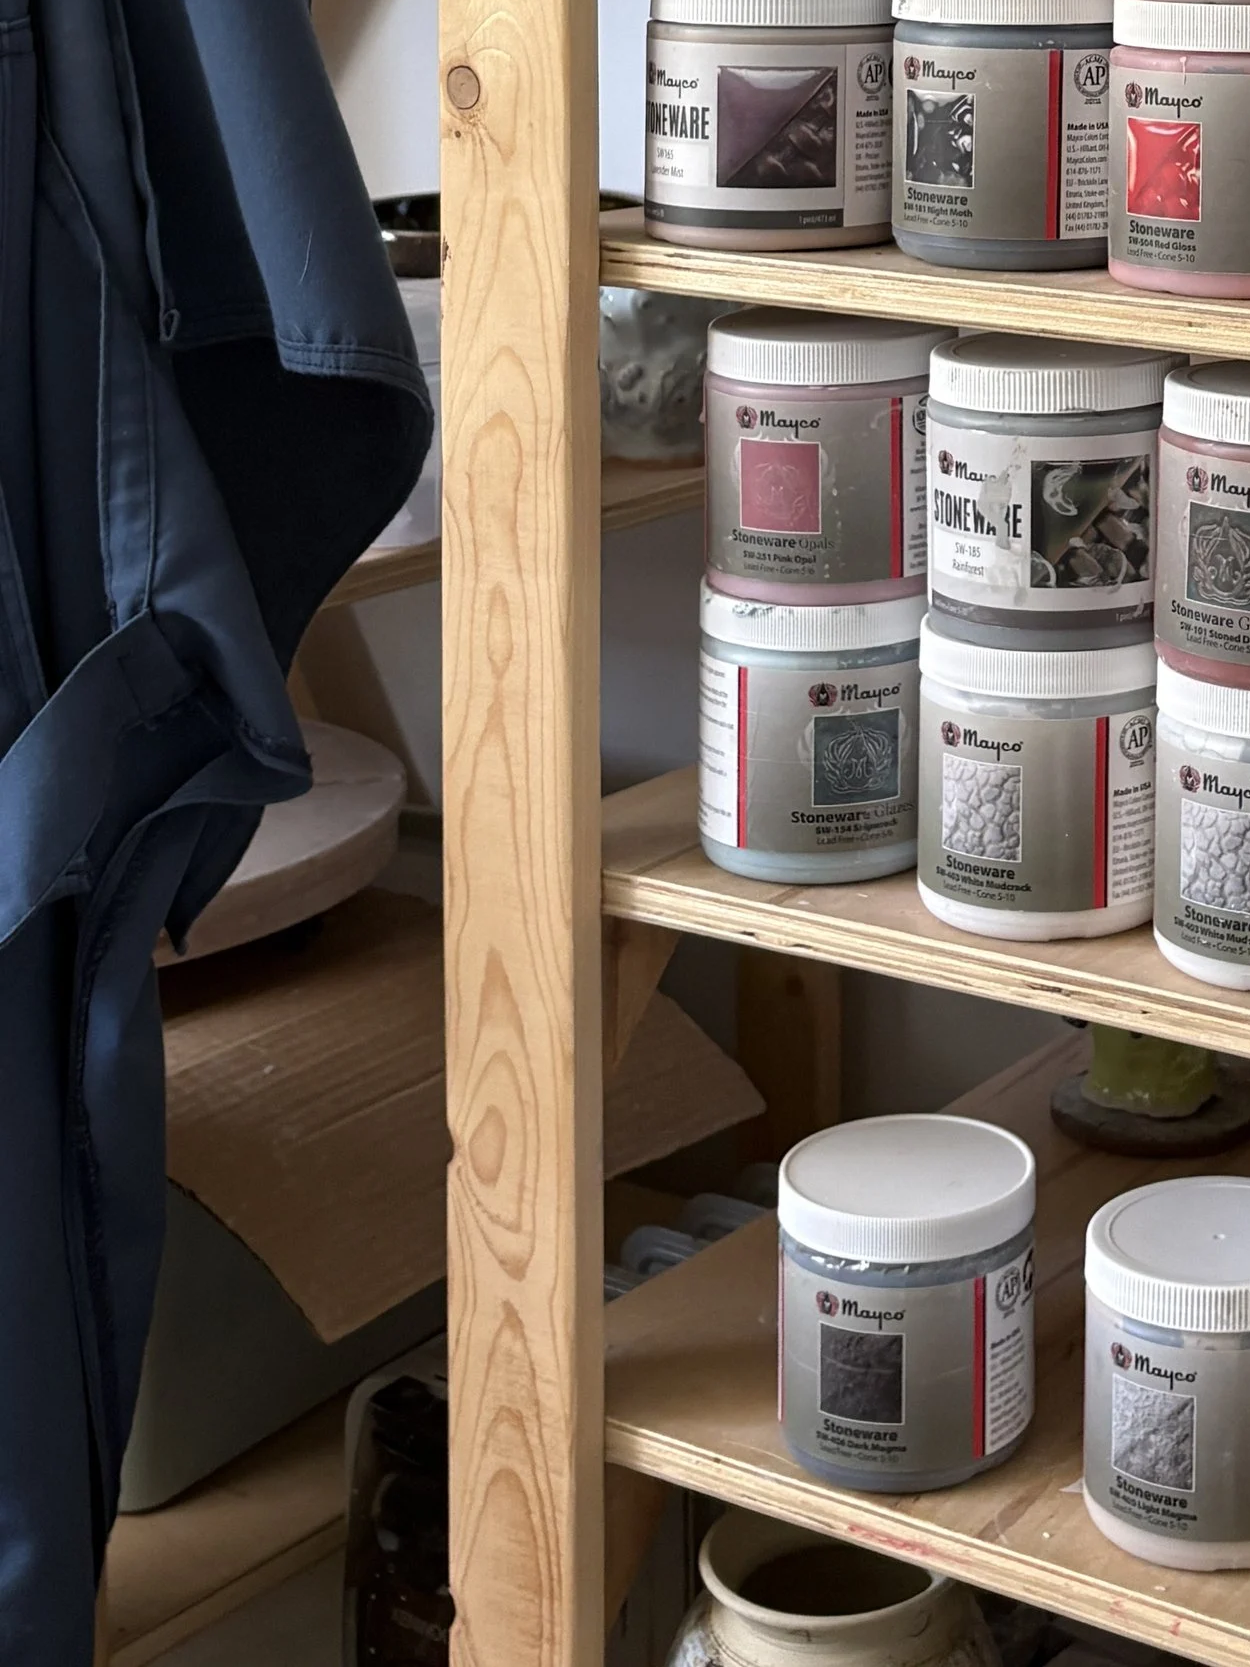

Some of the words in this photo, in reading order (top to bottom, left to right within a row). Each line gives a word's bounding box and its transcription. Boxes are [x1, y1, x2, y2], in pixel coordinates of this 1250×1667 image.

[657, 68, 699, 99] Mayco
[864, 62, 882, 84] AP
[922, 60, 977, 90] Mayco
[1083, 66, 1106, 86] AP
[1144, 87, 1203, 118] Mayco
[907, 188, 968, 206] Stoneware
[1130, 221, 1195, 240] Stoneware
[760, 411, 821, 438] Mayco
[732, 530, 796, 549] Stoneware
[799, 536, 834, 551] Opals
[1171, 600, 1234, 629] Stoneware
[841, 683, 902, 707] Mayco
[963, 729, 1023, 761] Mayco
[1127, 727, 1147, 750] AP
[791, 809, 870, 824] Stoneware
[946, 855, 1015, 879] Stoneware
[841, 1299, 905, 1330] Mayco
[1134, 1353, 1198, 1390] Mayco
[823, 1419, 898, 1442] Stoneware
[1116, 1476, 1188, 1509] Stoneware
